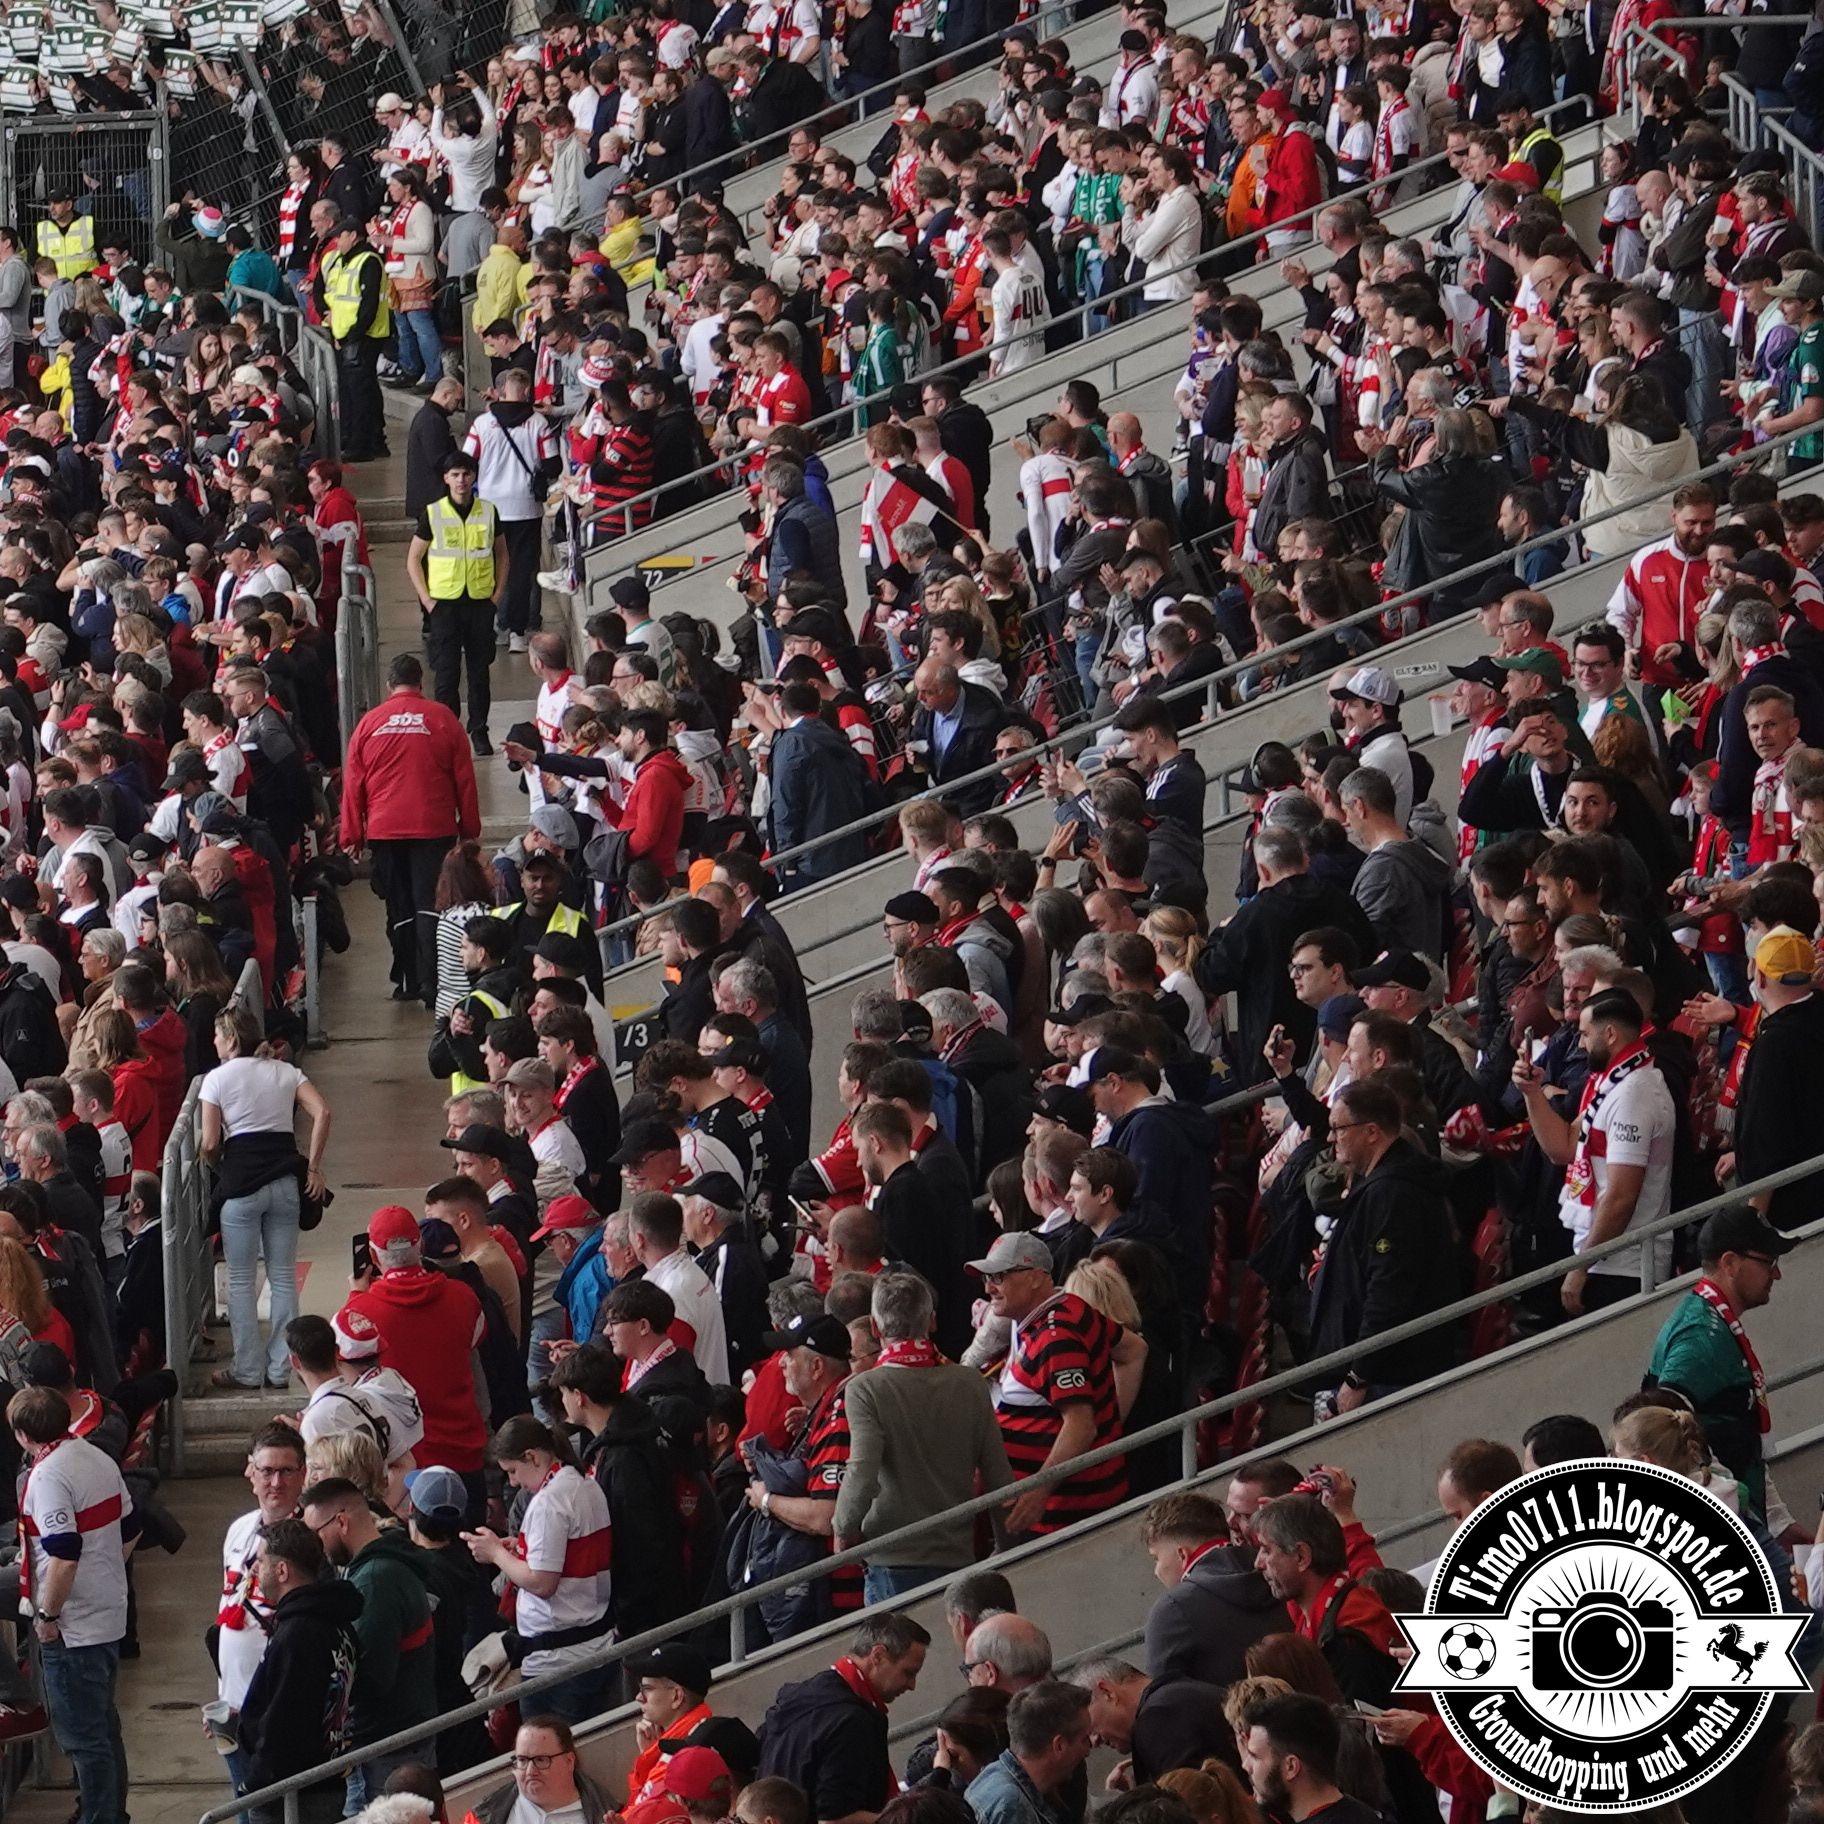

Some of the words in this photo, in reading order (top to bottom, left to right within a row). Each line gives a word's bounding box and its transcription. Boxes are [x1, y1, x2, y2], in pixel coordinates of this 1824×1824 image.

[388, 712, 424, 727] SDS
[1614, 1131, 1642, 1144] solar
[1056, 1372, 1086, 1389] EQ
[44, 1511, 69, 1529] EQ
